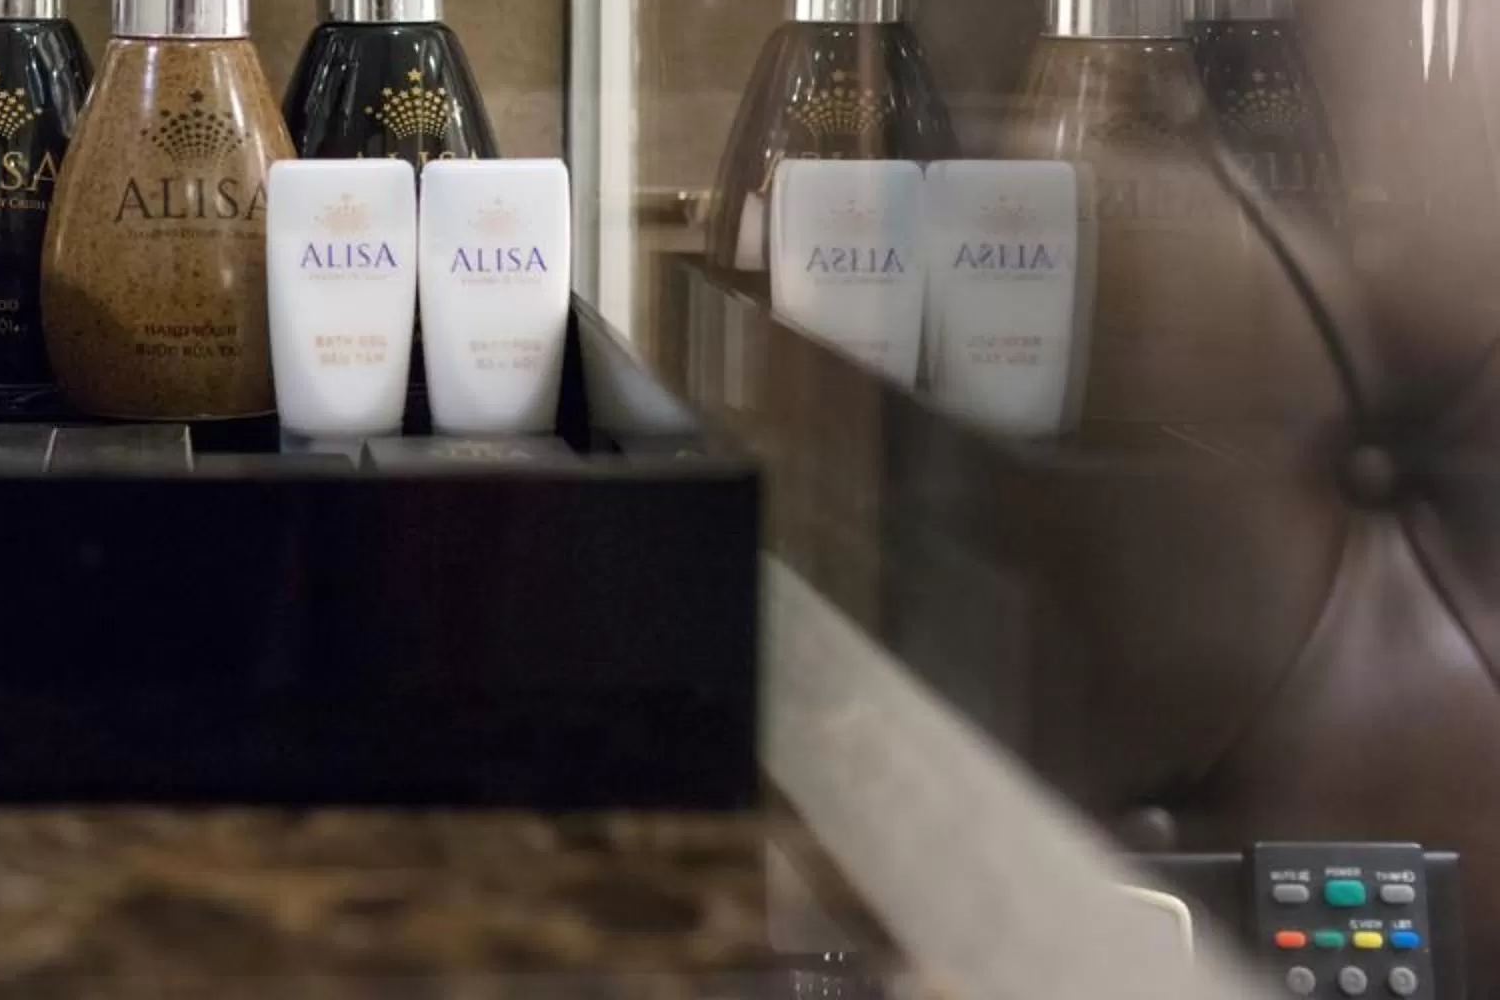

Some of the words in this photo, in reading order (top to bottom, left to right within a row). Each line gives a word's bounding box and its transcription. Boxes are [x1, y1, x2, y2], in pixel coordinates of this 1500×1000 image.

[115, 176, 268, 223] ALISA
[300, 242, 399, 269] ALISA
[450, 245, 547, 274] ALISA
[1325, 867, 1361, 877] POWER
